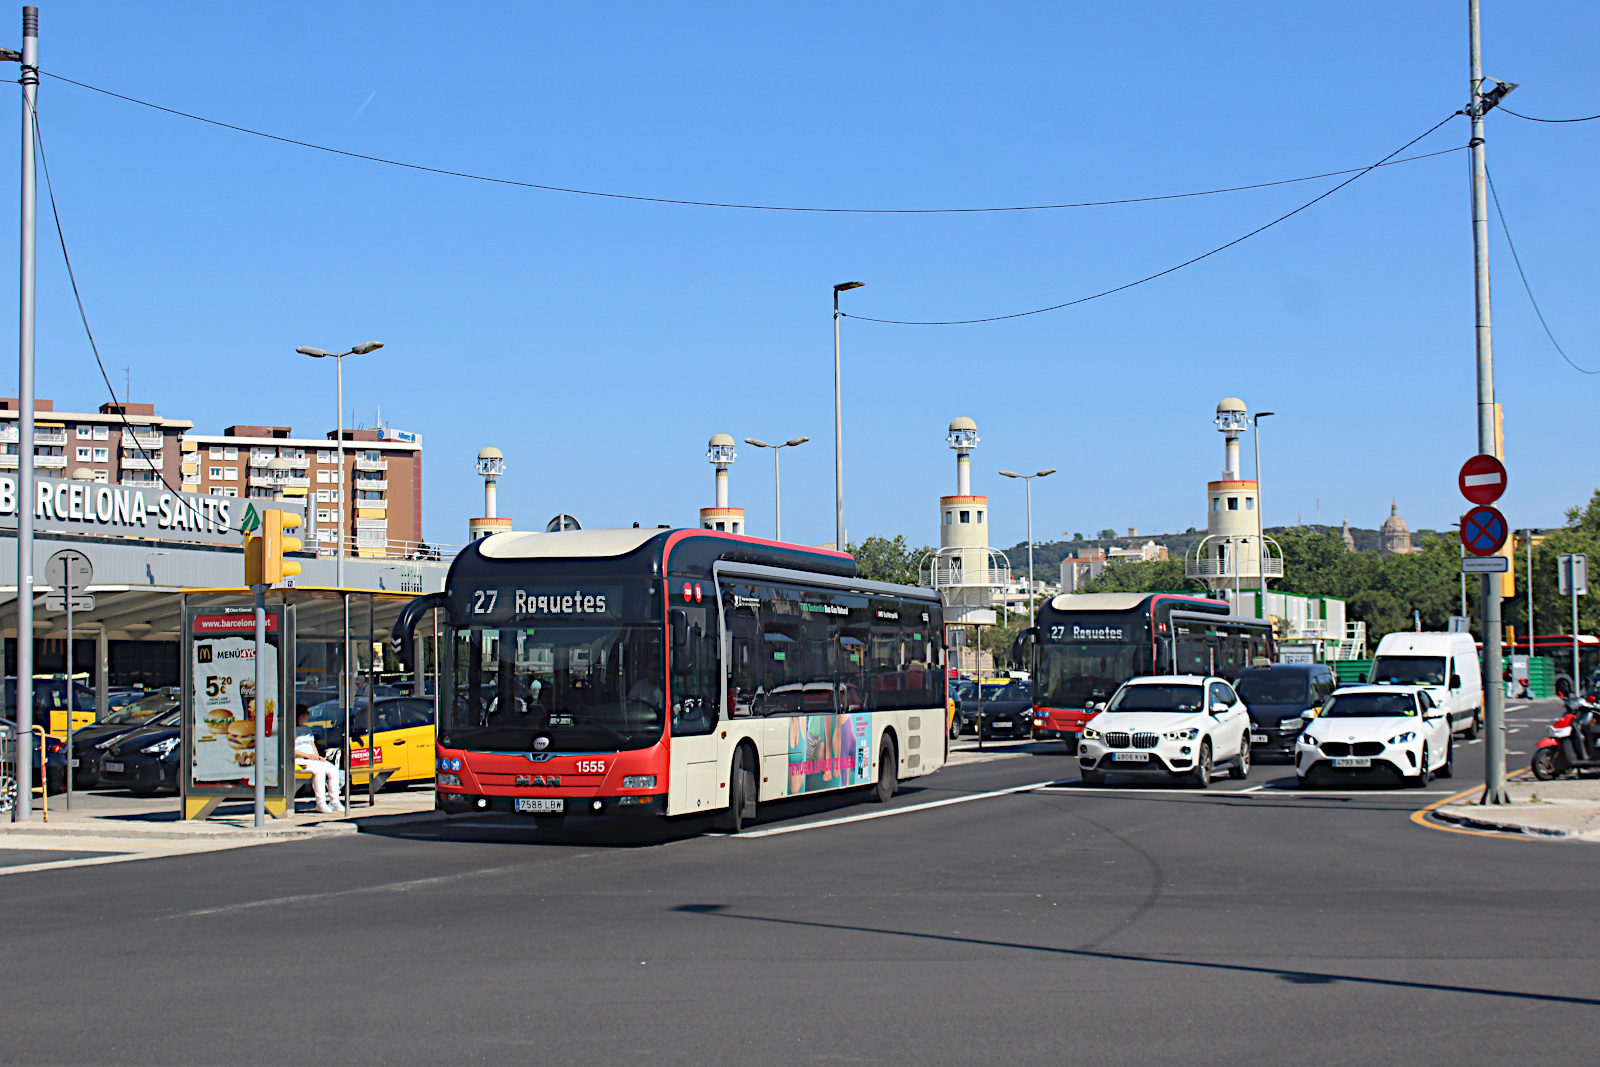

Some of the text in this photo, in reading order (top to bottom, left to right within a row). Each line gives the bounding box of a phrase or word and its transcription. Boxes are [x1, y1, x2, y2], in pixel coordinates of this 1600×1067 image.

[0, 477, 231, 532] BRCELONA-SANTS
[474, 589, 606, 614] 27 Roquetes
[201, 618, 271, 628] www.barcelonaat
[1051, 625, 1123, 639] 27 Roquetes
[576, 761, 605, 773] 1555
[515, 775, 561, 788] MAN
[521, 800, 562, 810] 7588 LBW
